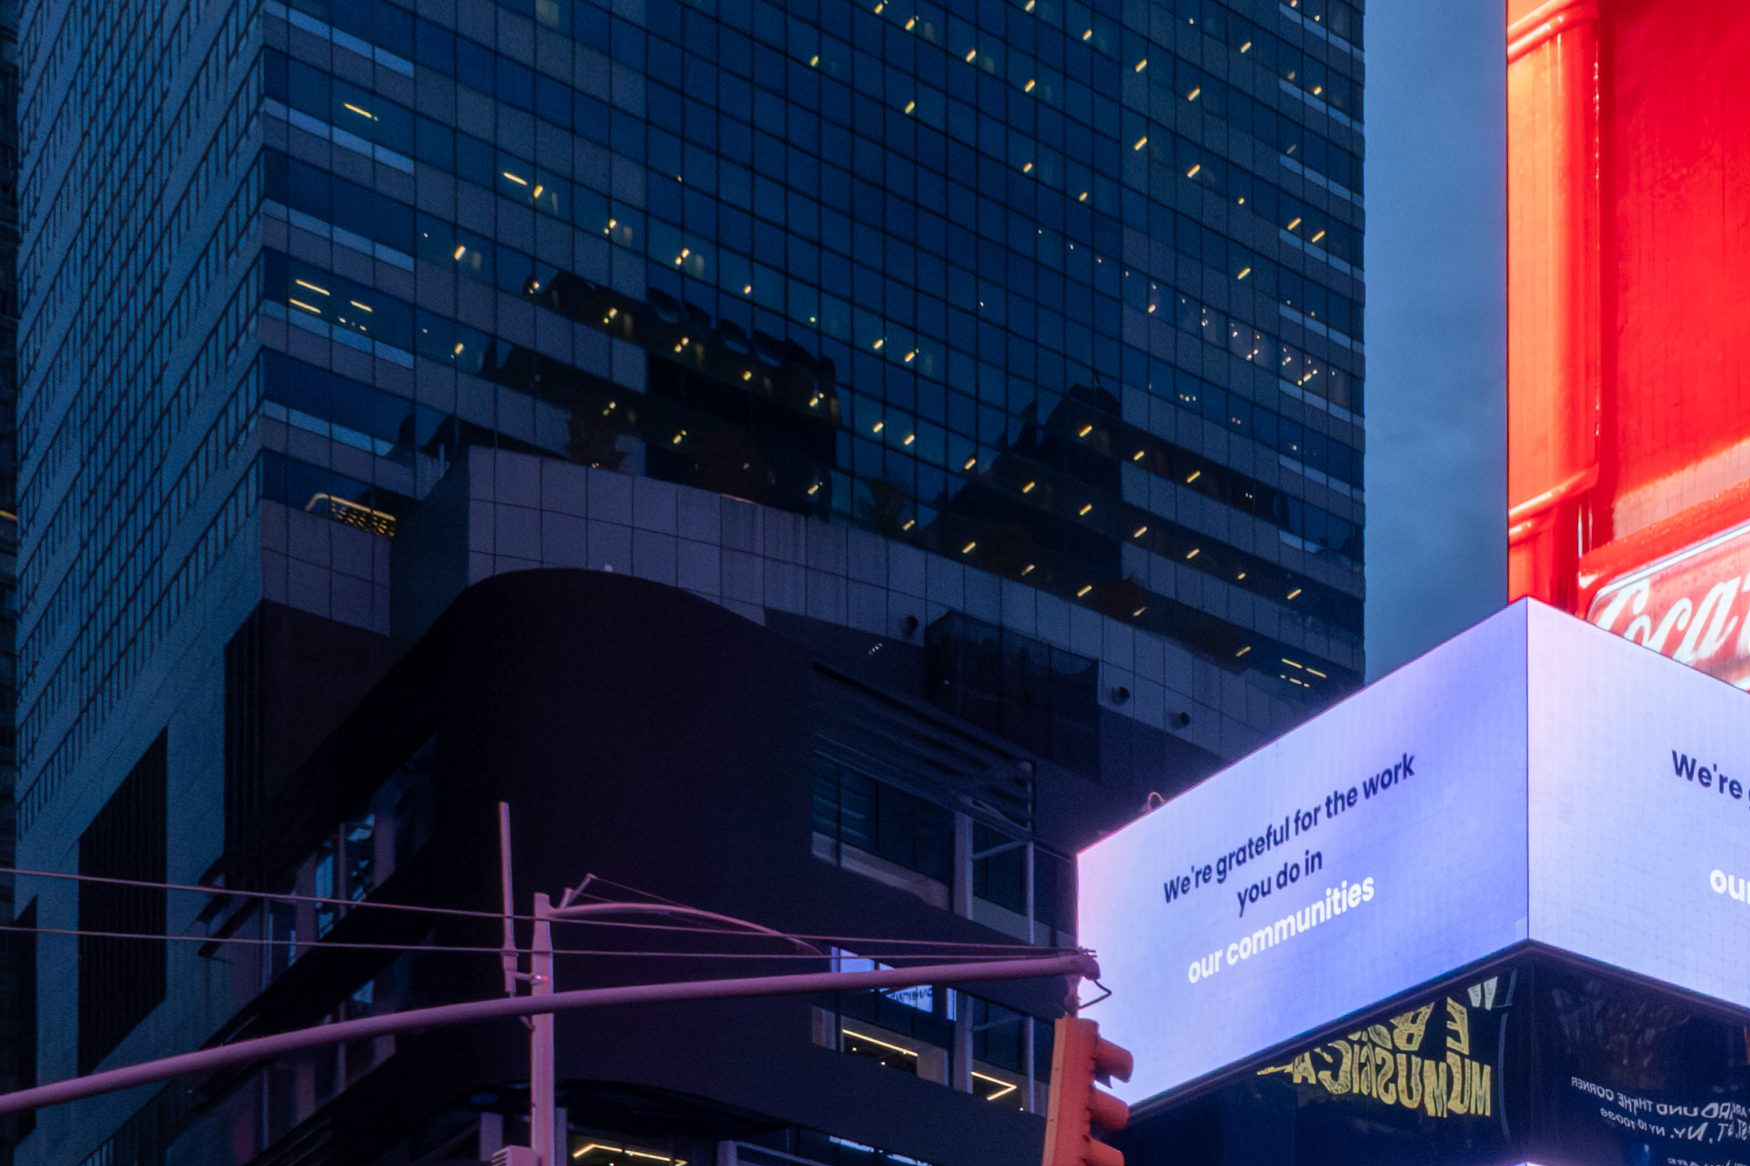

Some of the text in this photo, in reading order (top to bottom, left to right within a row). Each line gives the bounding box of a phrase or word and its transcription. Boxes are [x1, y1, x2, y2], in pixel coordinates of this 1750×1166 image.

[1672, 749, 1743, 799] We're
[1163, 752, 1415, 904] We're grateful for the work
[1237, 849, 1323, 918] you do in
[1188, 876, 1375, 984] our communities
